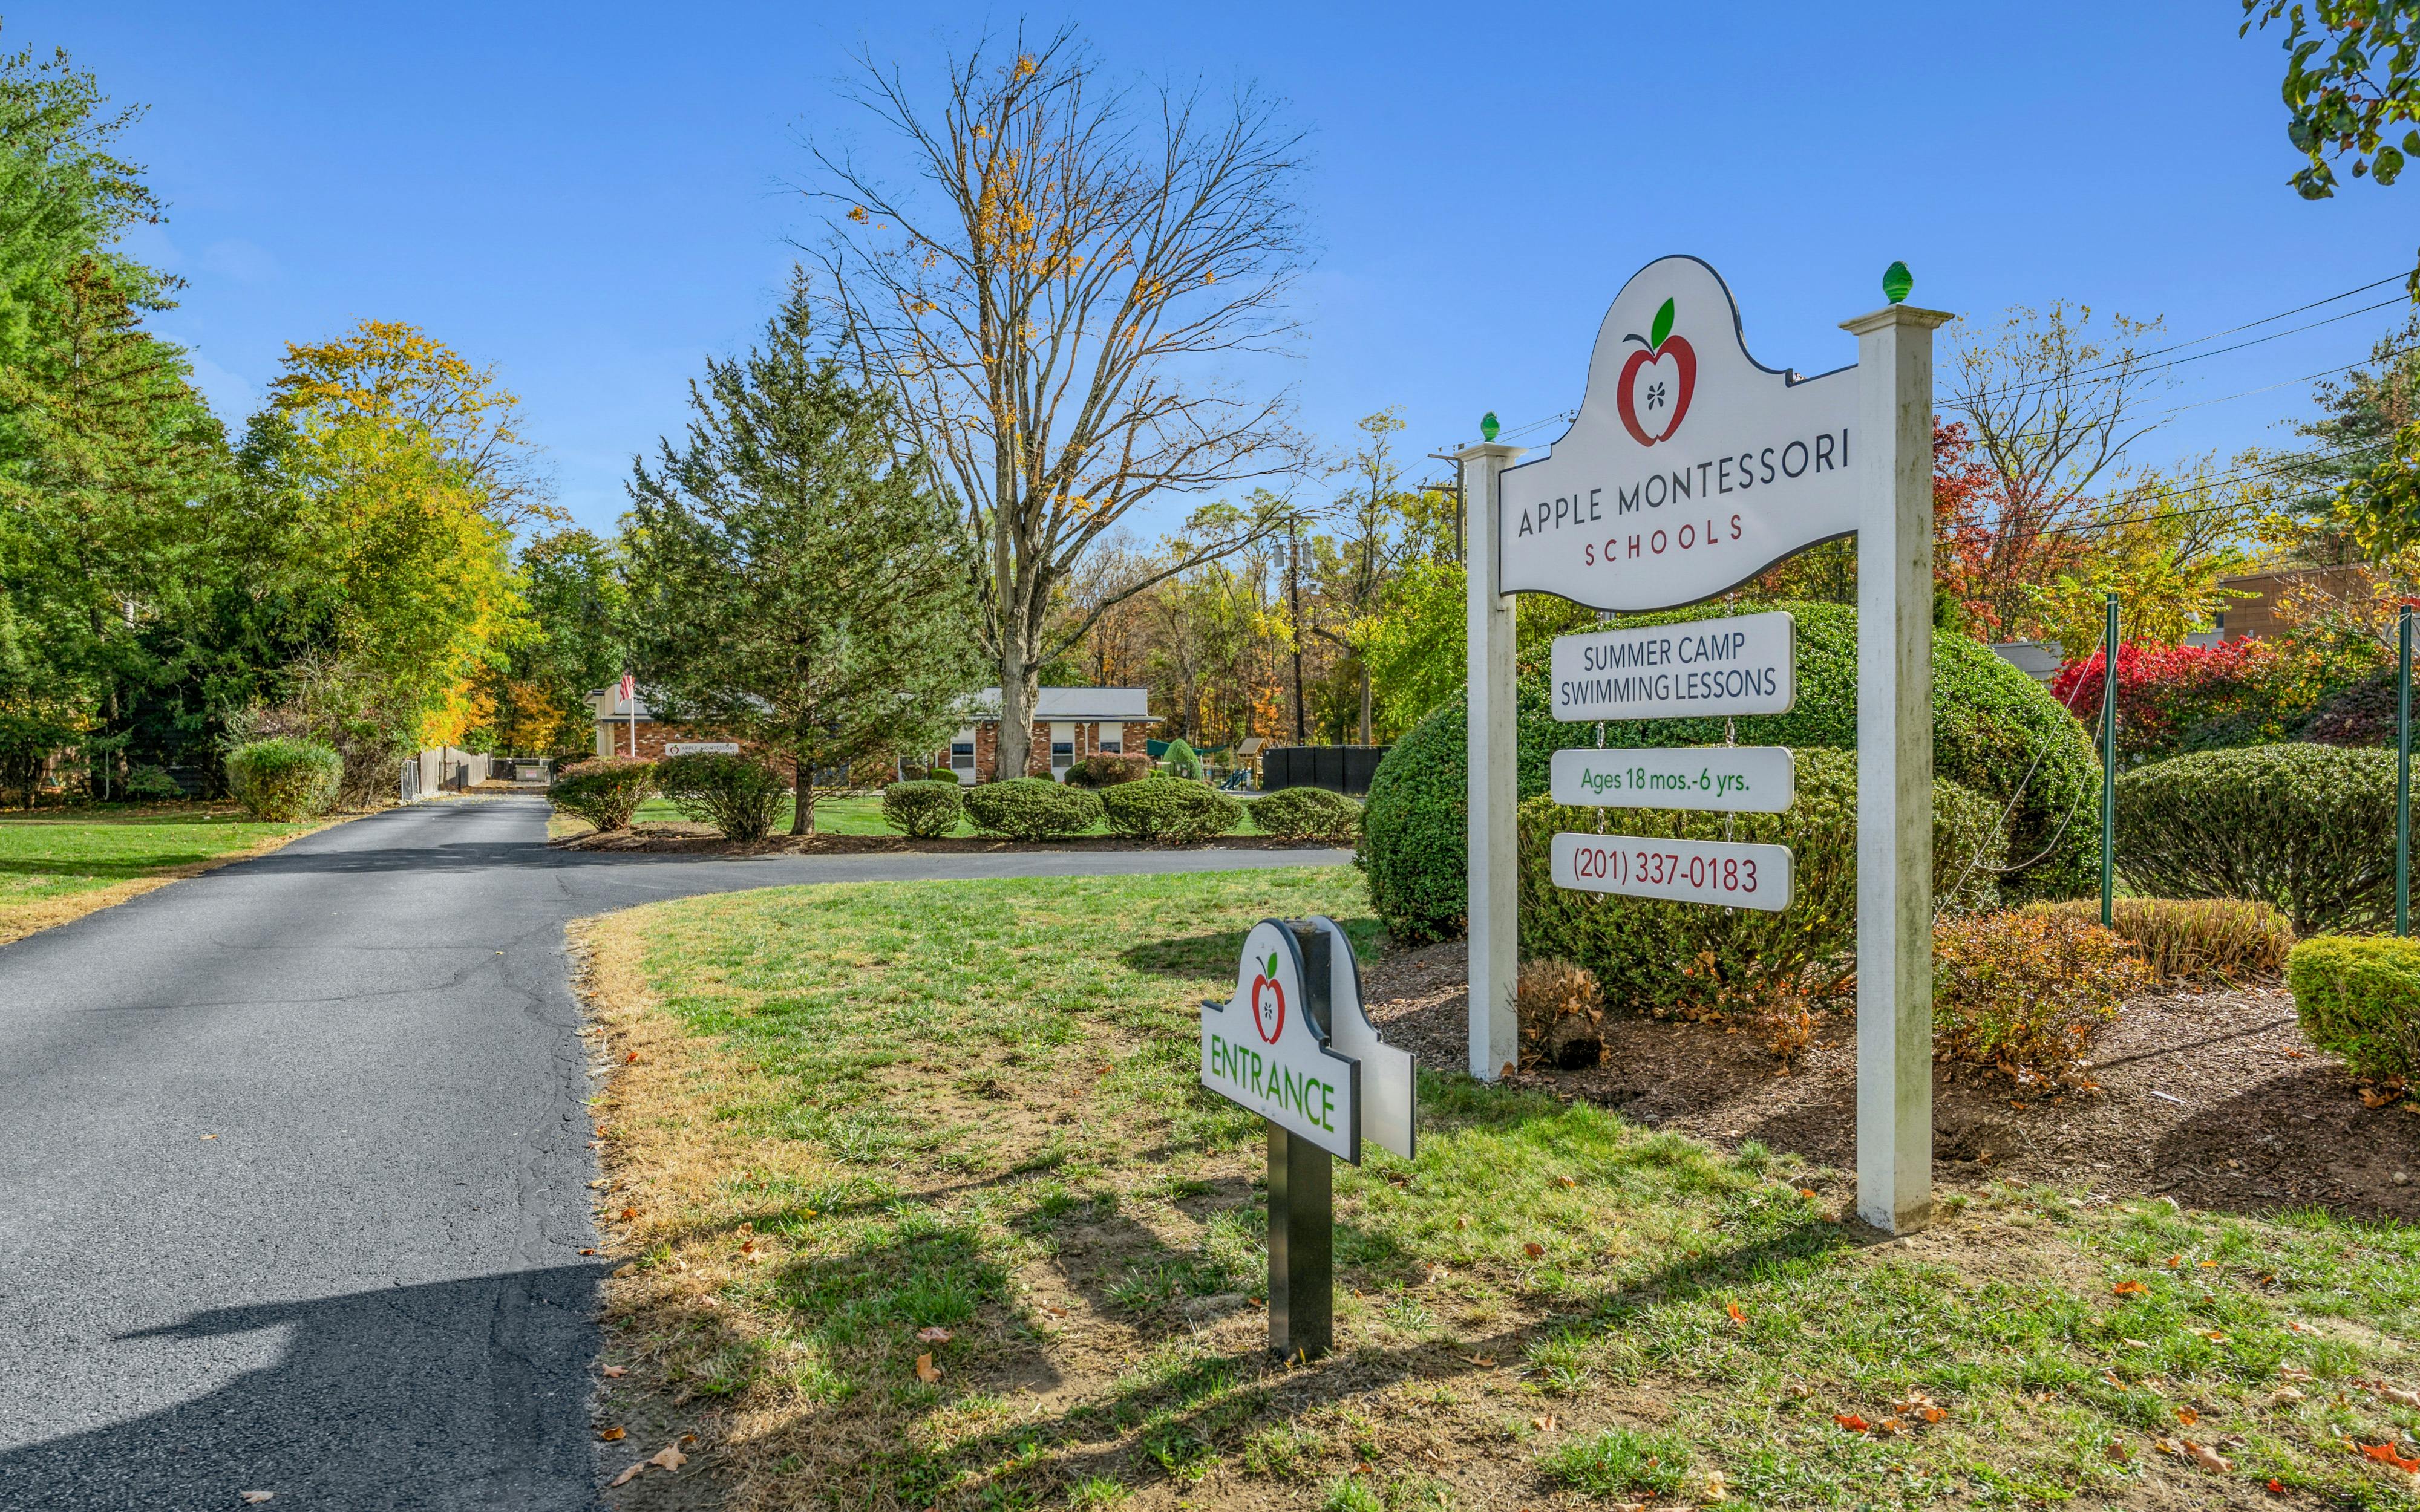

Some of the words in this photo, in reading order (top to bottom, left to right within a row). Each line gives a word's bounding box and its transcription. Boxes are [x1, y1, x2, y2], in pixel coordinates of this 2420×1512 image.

[1518, 488, 1602, 537] APPLE
[1619, 428, 1848, 515] MONTESSORI
[1585, 515, 1742, 566] SCHOOLS
[1584, 639, 1671, 671] SUMMER
[1678, 632, 1745, 664] CAMP
[1561, 674, 1670, 706] SWIMMING
[1675, 667, 1776, 700] LESSONS
[1581, 768, 1621, 795] Ages
[1626, 768, 1645, 789] 18
[1716, 772, 1750, 797] yrs.
[1574, 847, 1627, 885] (201)
[1635, 852, 1758, 893] 337-0183
[1211, 1034, 1335, 1133] ENTRANCE
